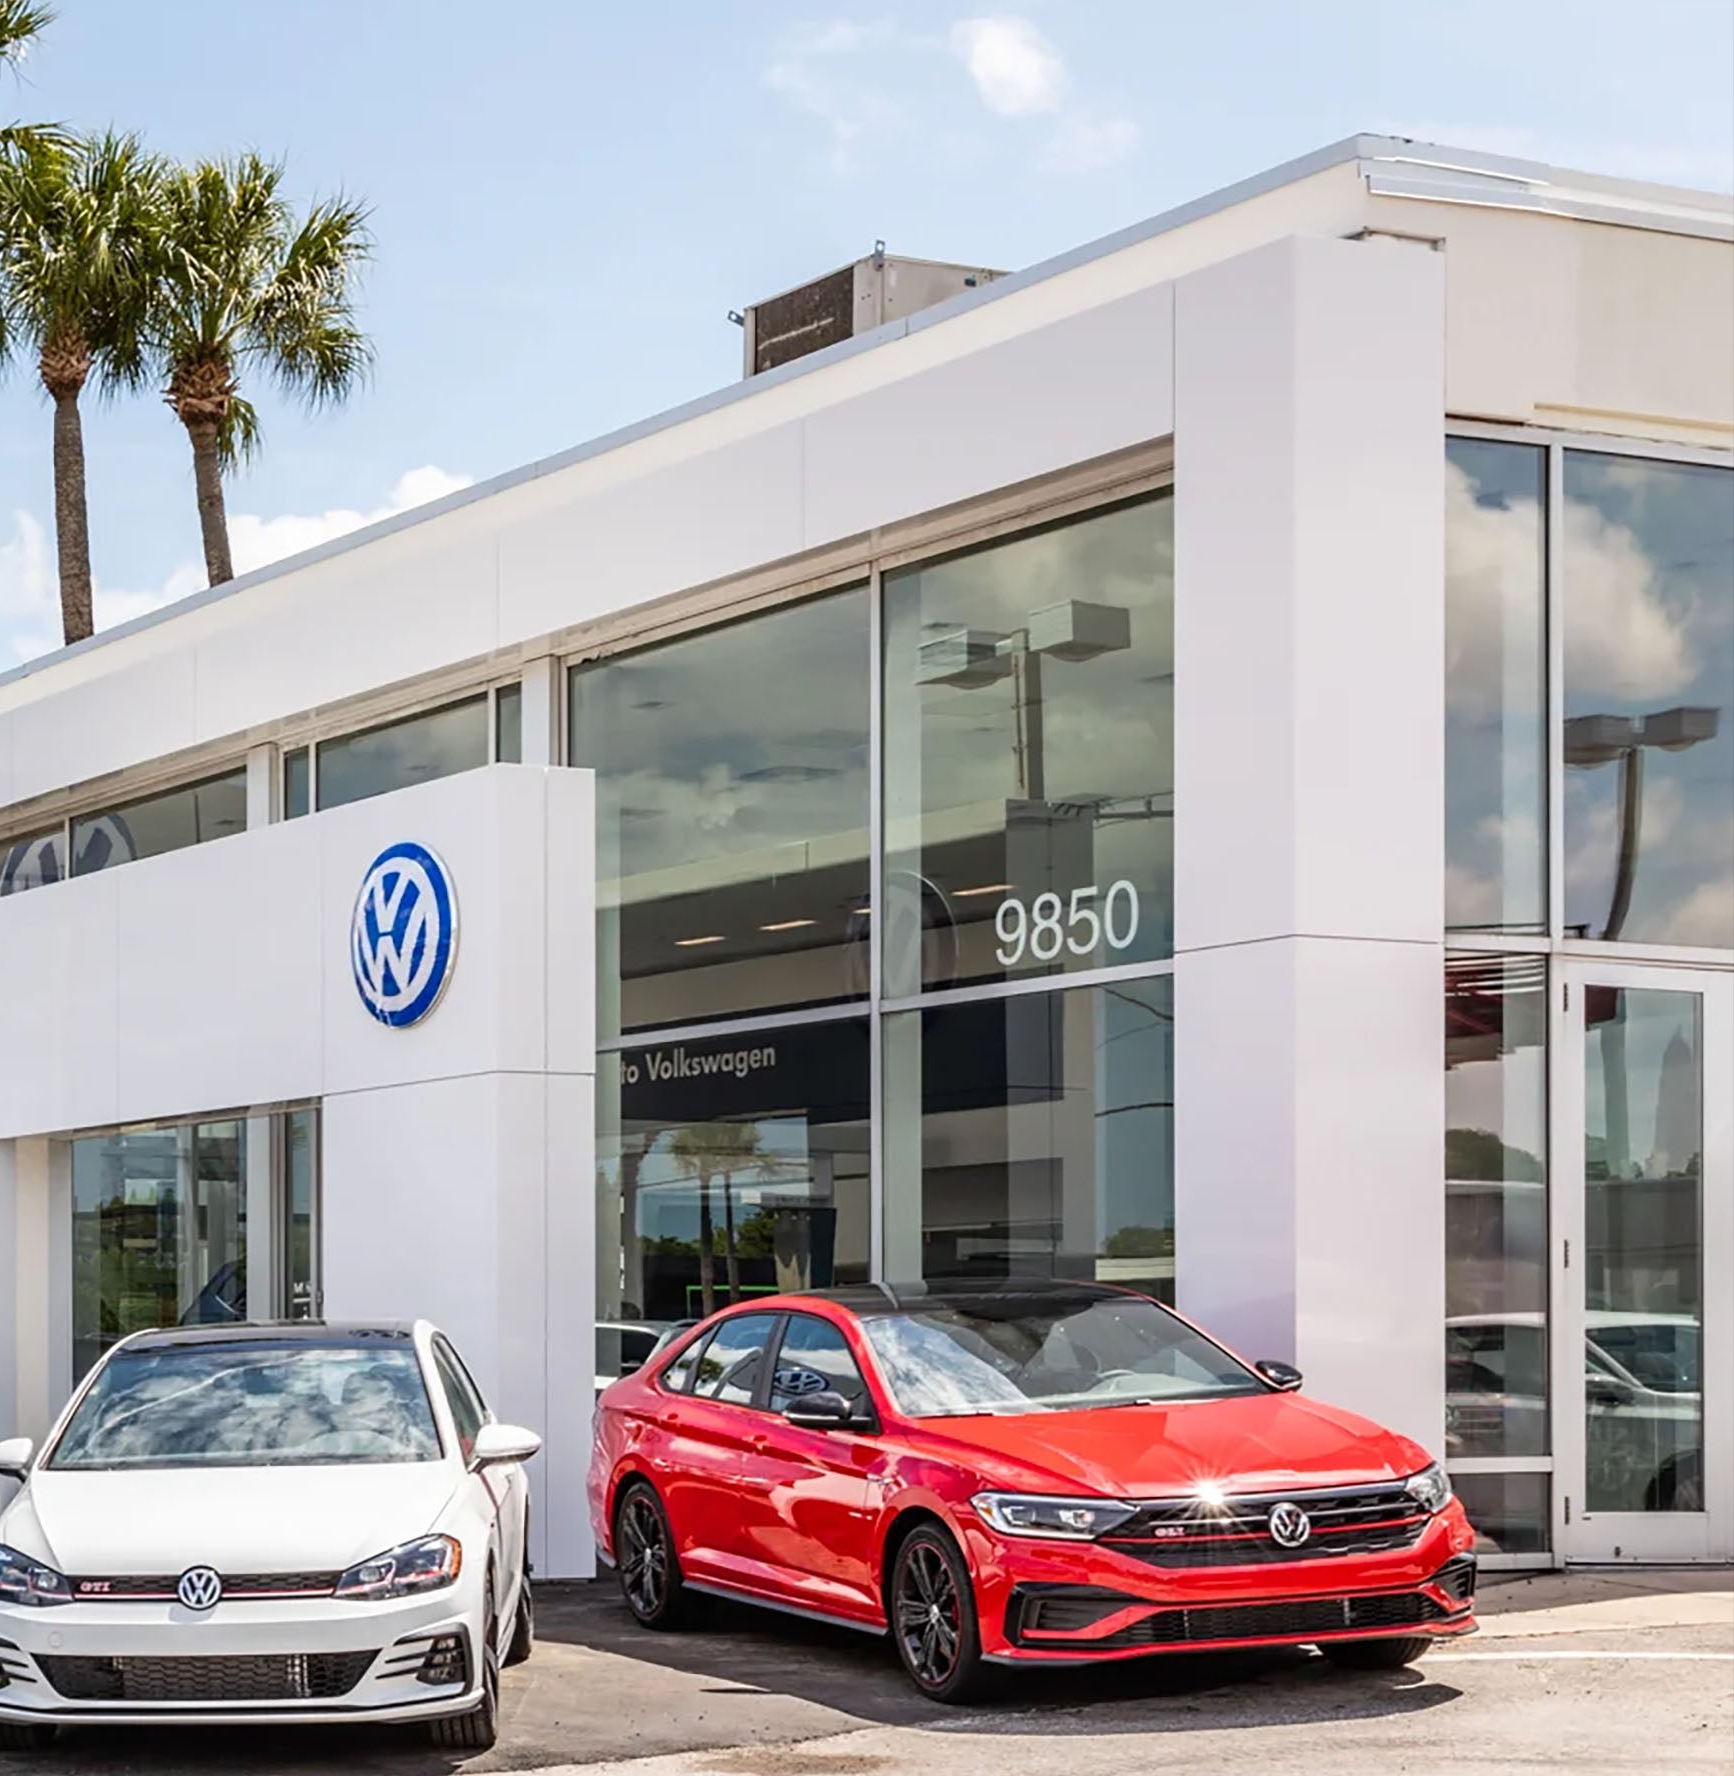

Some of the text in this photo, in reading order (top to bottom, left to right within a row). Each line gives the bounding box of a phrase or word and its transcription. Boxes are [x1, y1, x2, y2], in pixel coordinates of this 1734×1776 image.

[995, 879, 1139, 966] 9850
[645, 1047, 776, 1082] Volkswagen
[80, 1581, 111, 1592] GTI
